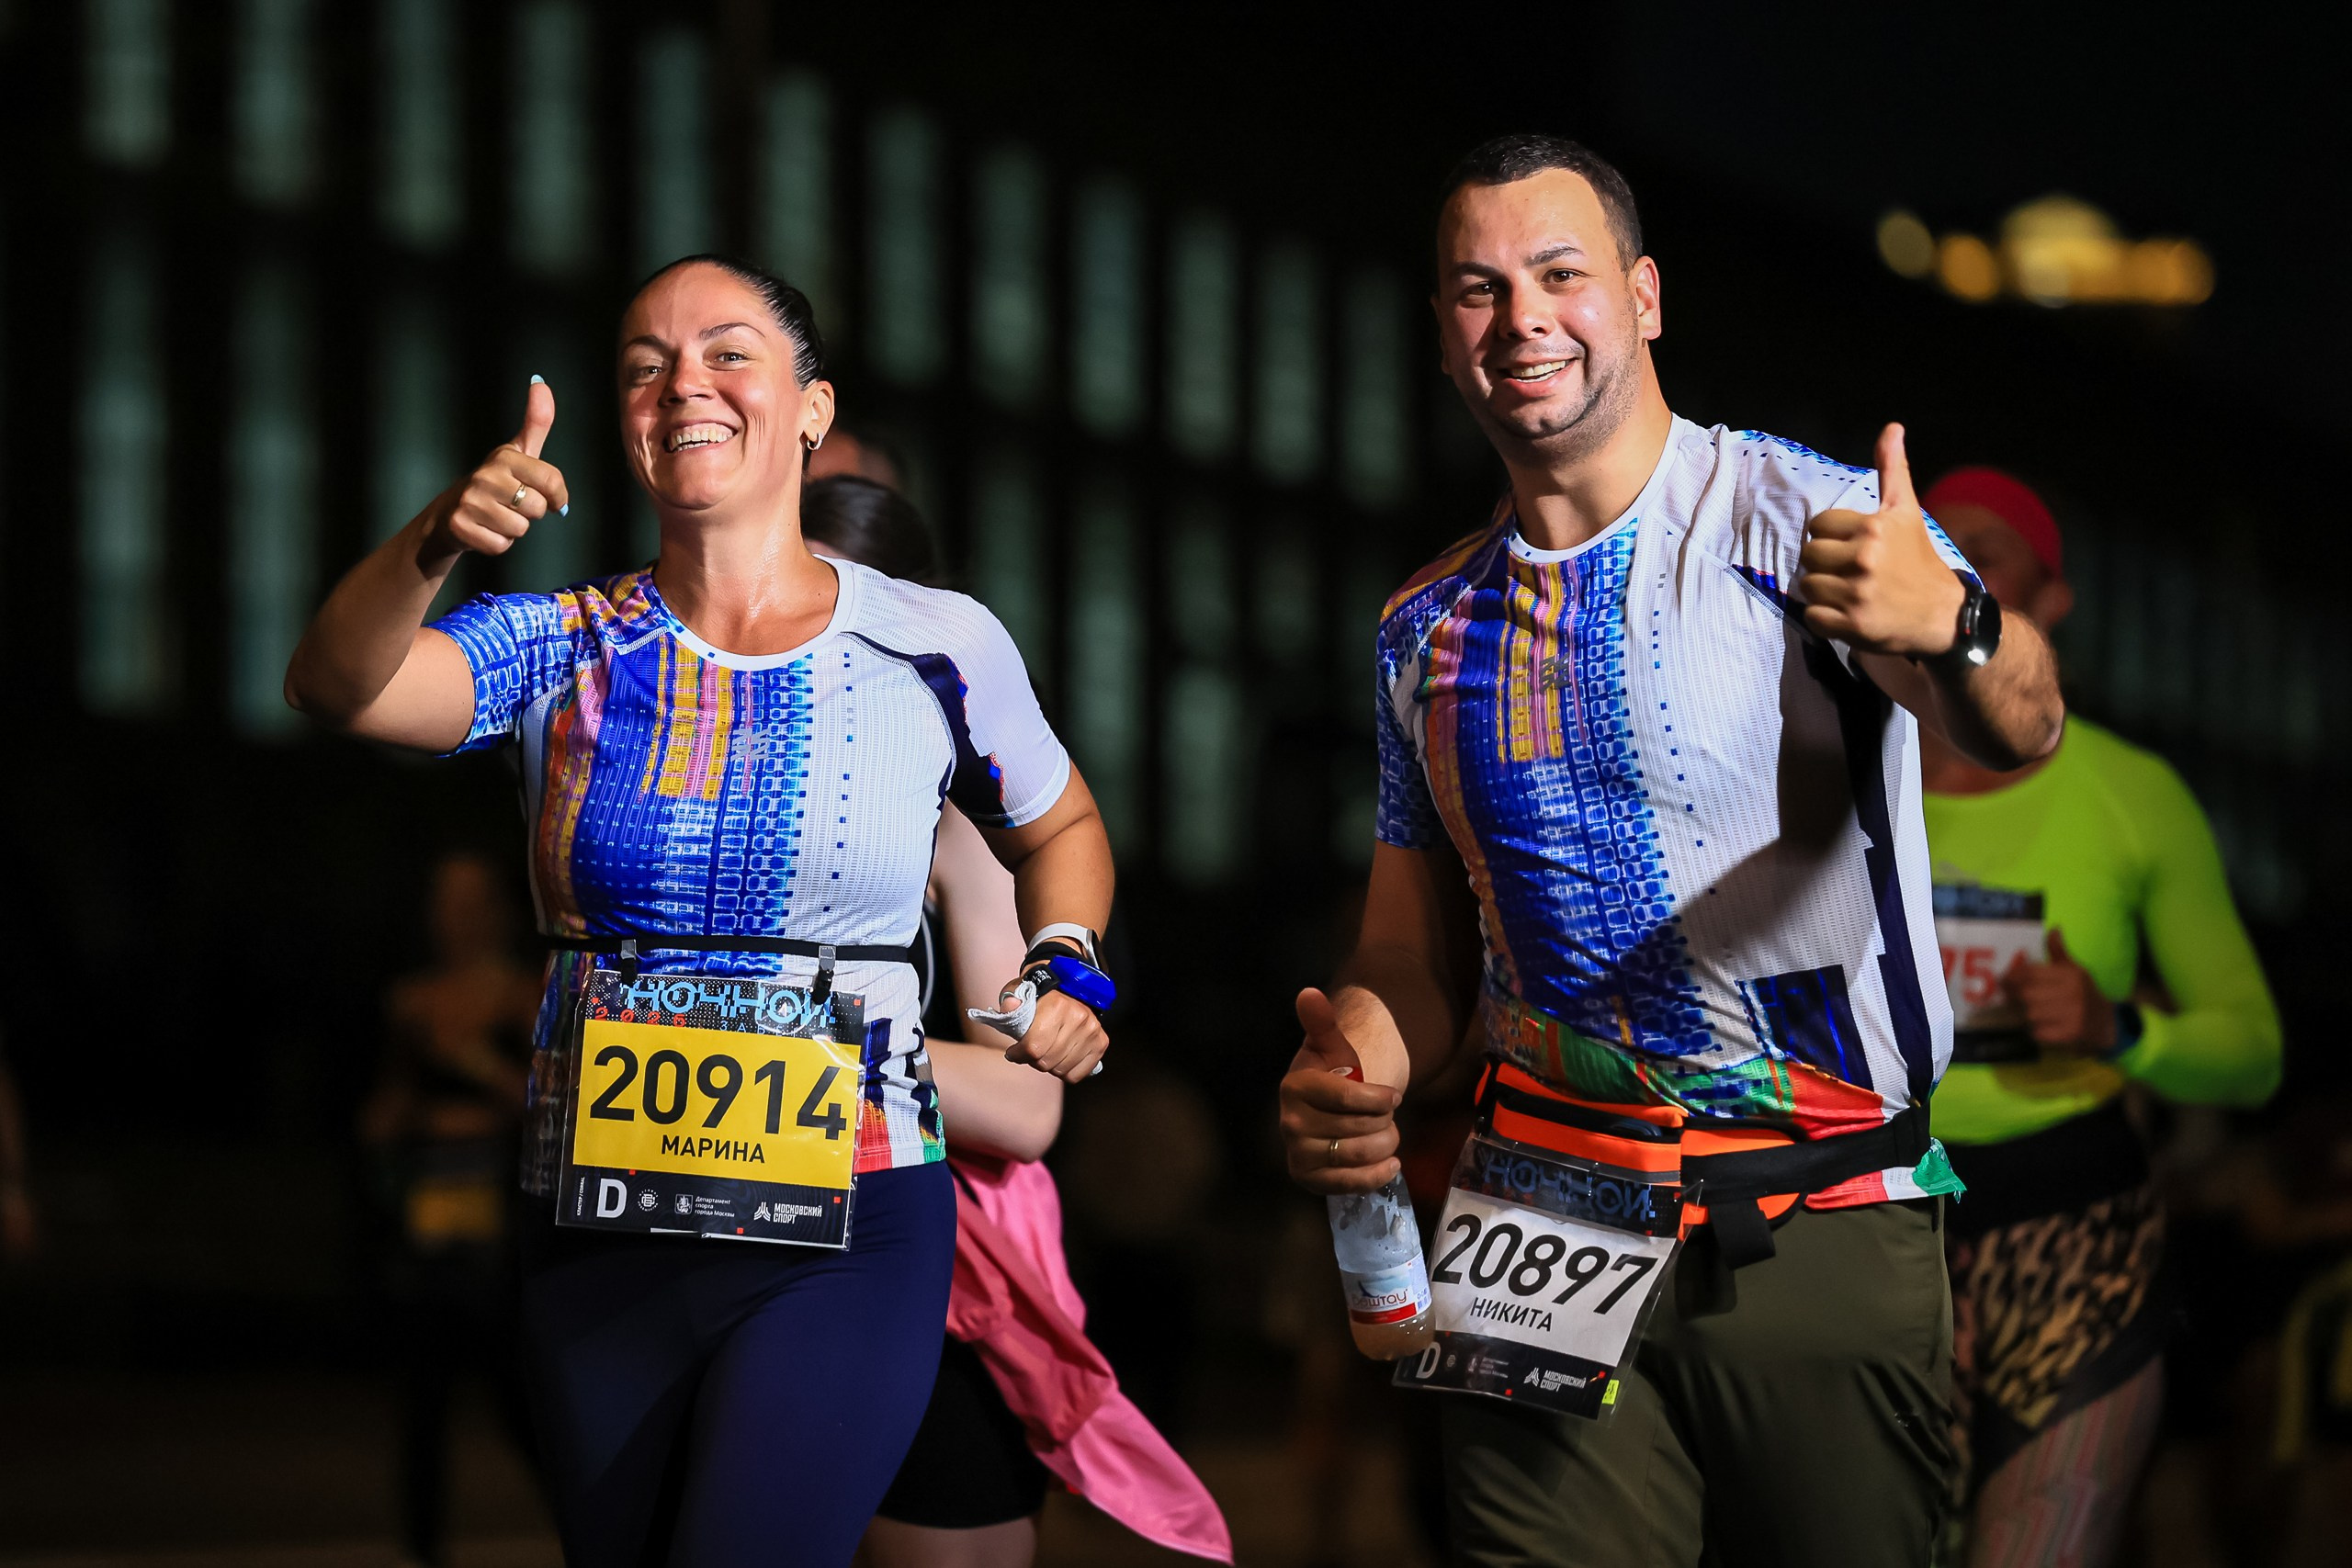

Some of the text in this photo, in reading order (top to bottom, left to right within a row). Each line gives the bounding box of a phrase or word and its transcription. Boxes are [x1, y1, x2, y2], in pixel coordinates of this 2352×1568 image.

[594, 1007, 686, 1027] 2026
[590, 1045, 847, 1140] 20914
[661, 1134, 765, 1164] МАРИНА
[596, 1178, 628, 1218] D
[695, 1196, 731, 1205] Департамент
[773, 1213, 797, 1224] СПОРТ
[774, 1202, 822, 1217] МОСКОВСКИЙ
[1431, 1213, 1658, 1315] 20897
[1469, 1296, 1553, 1332] НИКИТА
[1540, 1379, 1562, 1393] СПОРТ
[1544, 1369, 1587, 1389] МОСКОВСКИЙ
